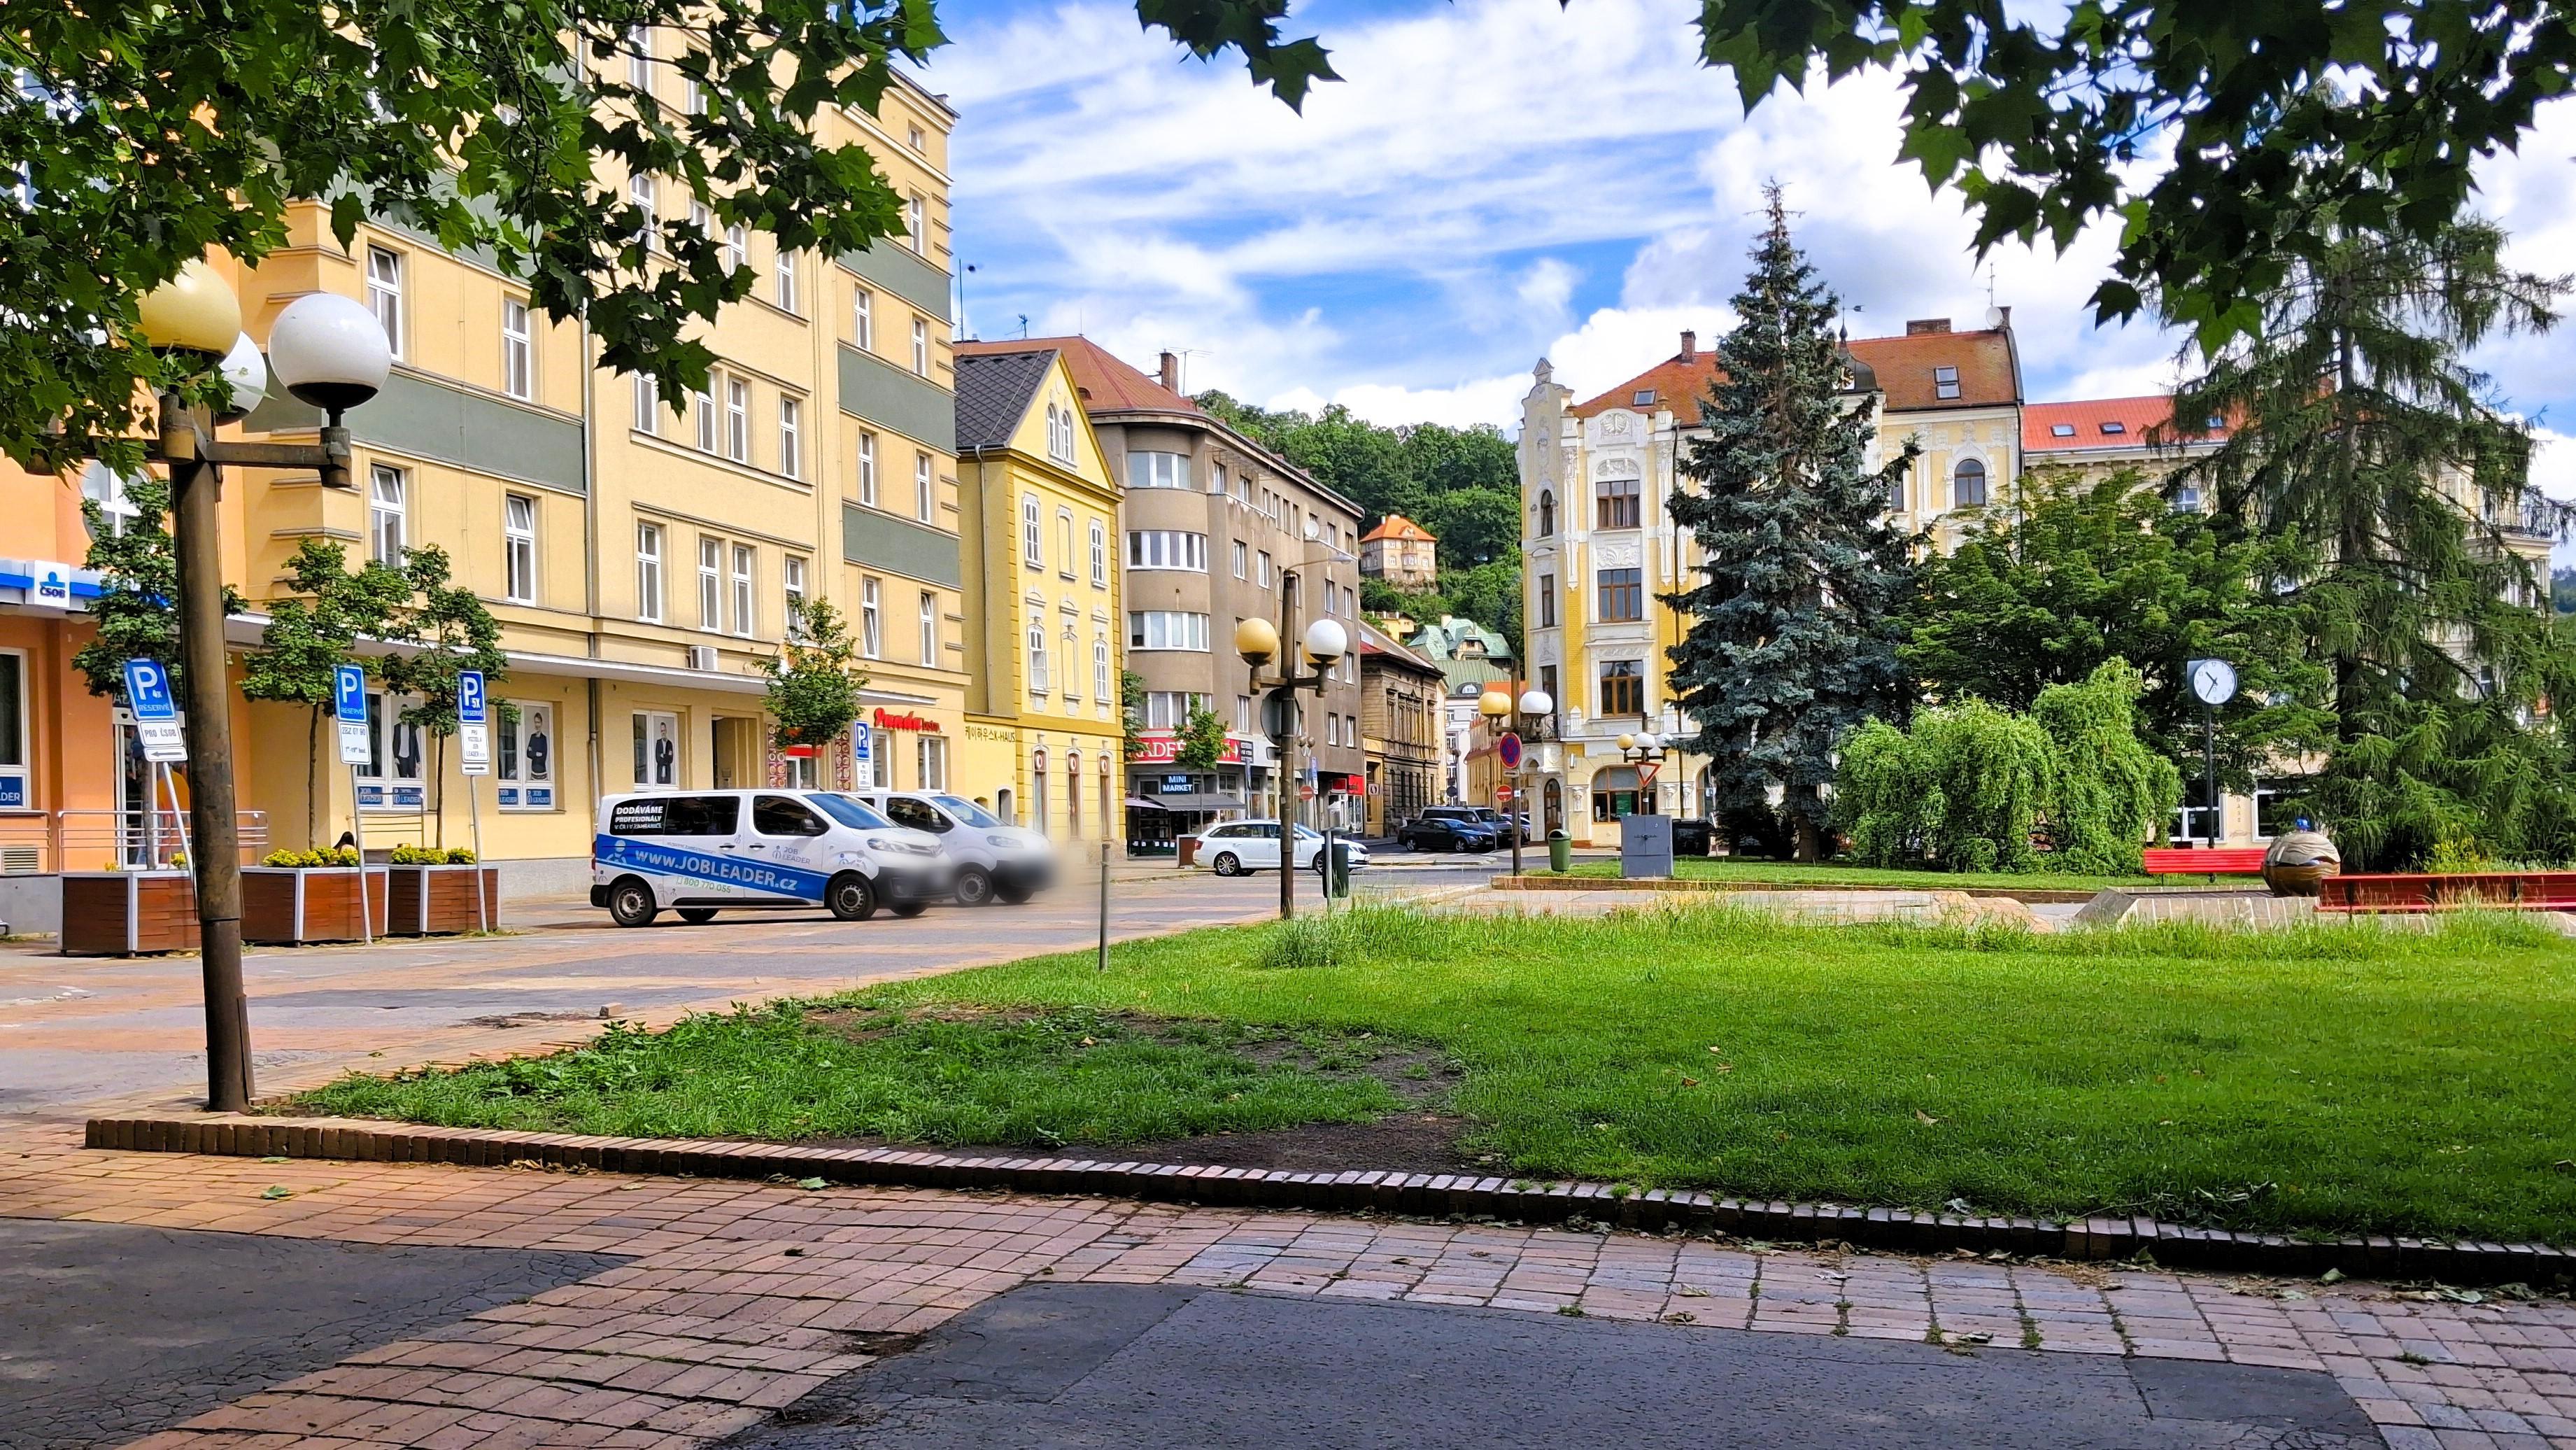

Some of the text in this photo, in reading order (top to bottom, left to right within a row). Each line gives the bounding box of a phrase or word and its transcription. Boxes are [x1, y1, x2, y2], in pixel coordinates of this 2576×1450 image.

[40, 586, 65, 598] ČSOB
[1163, 784, 1193, 792] MARKET
[0, 792, 20, 801] DER
[616, 805, 663, 815] DODÁVÁME
[783, 854, 810, 864] LEADER
[635, 850, 798, 891] www.JOBLEADER.cz
[684, 877, 731, 894] 800 770 055
